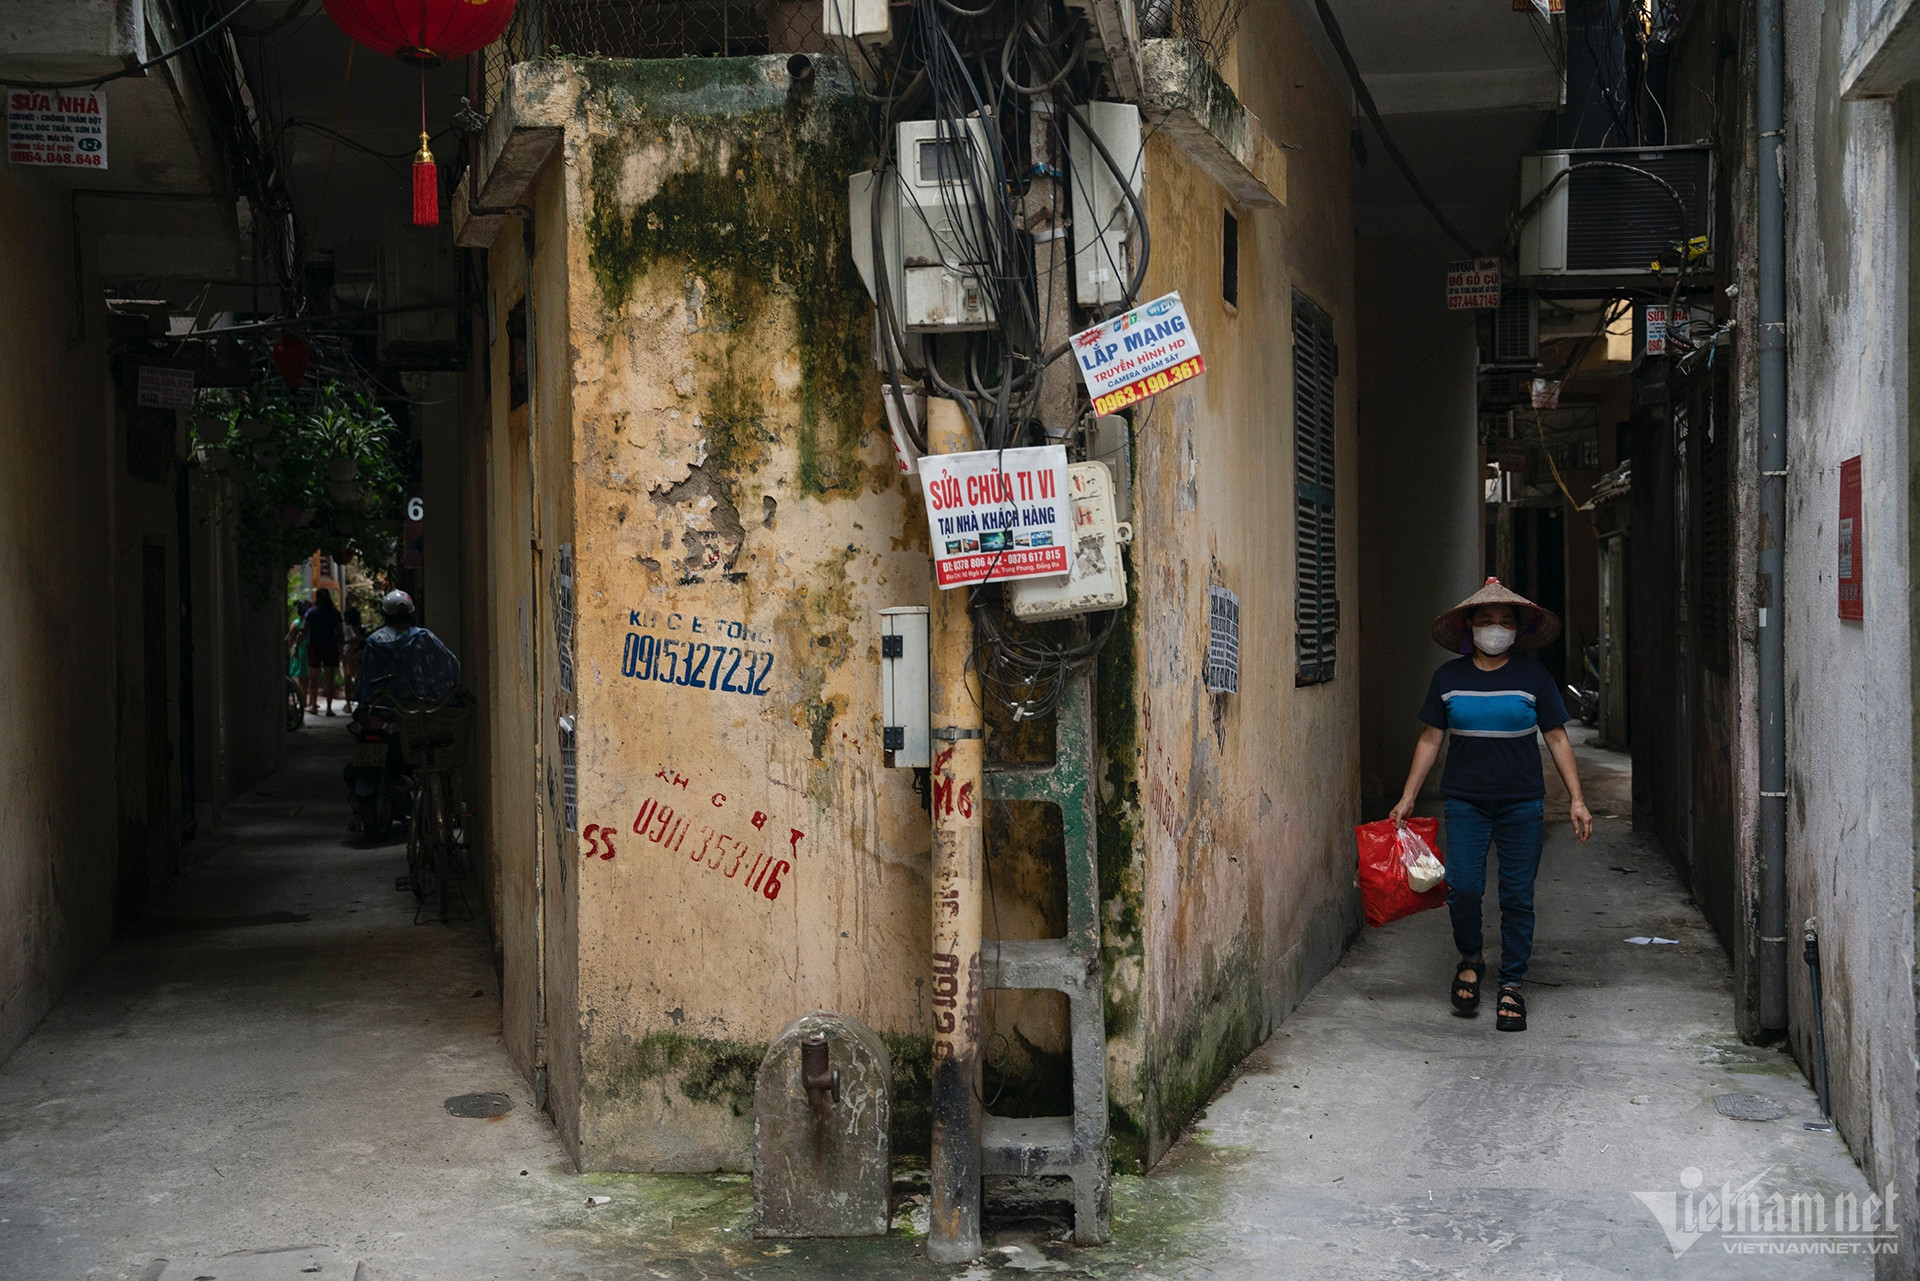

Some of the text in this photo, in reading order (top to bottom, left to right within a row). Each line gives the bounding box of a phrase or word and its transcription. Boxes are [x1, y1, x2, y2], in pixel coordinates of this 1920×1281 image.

[12, 90, 99, 114] SỬA NHÀ
[1449, 261, 1475, 273] MUA
[1082, 315, 1186, 371] LẮP MẠNG
[1094, 339, 1186, 383] TRUYỀN HÌNH HD
[1095, 358, 1200, 415] 0963.190.361
[1108, 353, 1179, 387] CAMERA GIÁM SÁT
[930, 468, 963, 510] SỬA
[1017, 471, 1034, 501] TI
[1037, 469, 1055, 499] VI
[407, 496, 424, 521] 6
[938, 517, 954, 538] TẠI
[957, 510, 979, 533] NHÀ
[981, 507, 1019, 530] KHÁCH
[1022, 505, 1055, 526] HÀNG
[1028, 551, 1043, 562] 617
[1045, 549, 1061, 560] 815
[621, 632, 774, 696] 0915327232
[583, 823, 617, 861] SS
